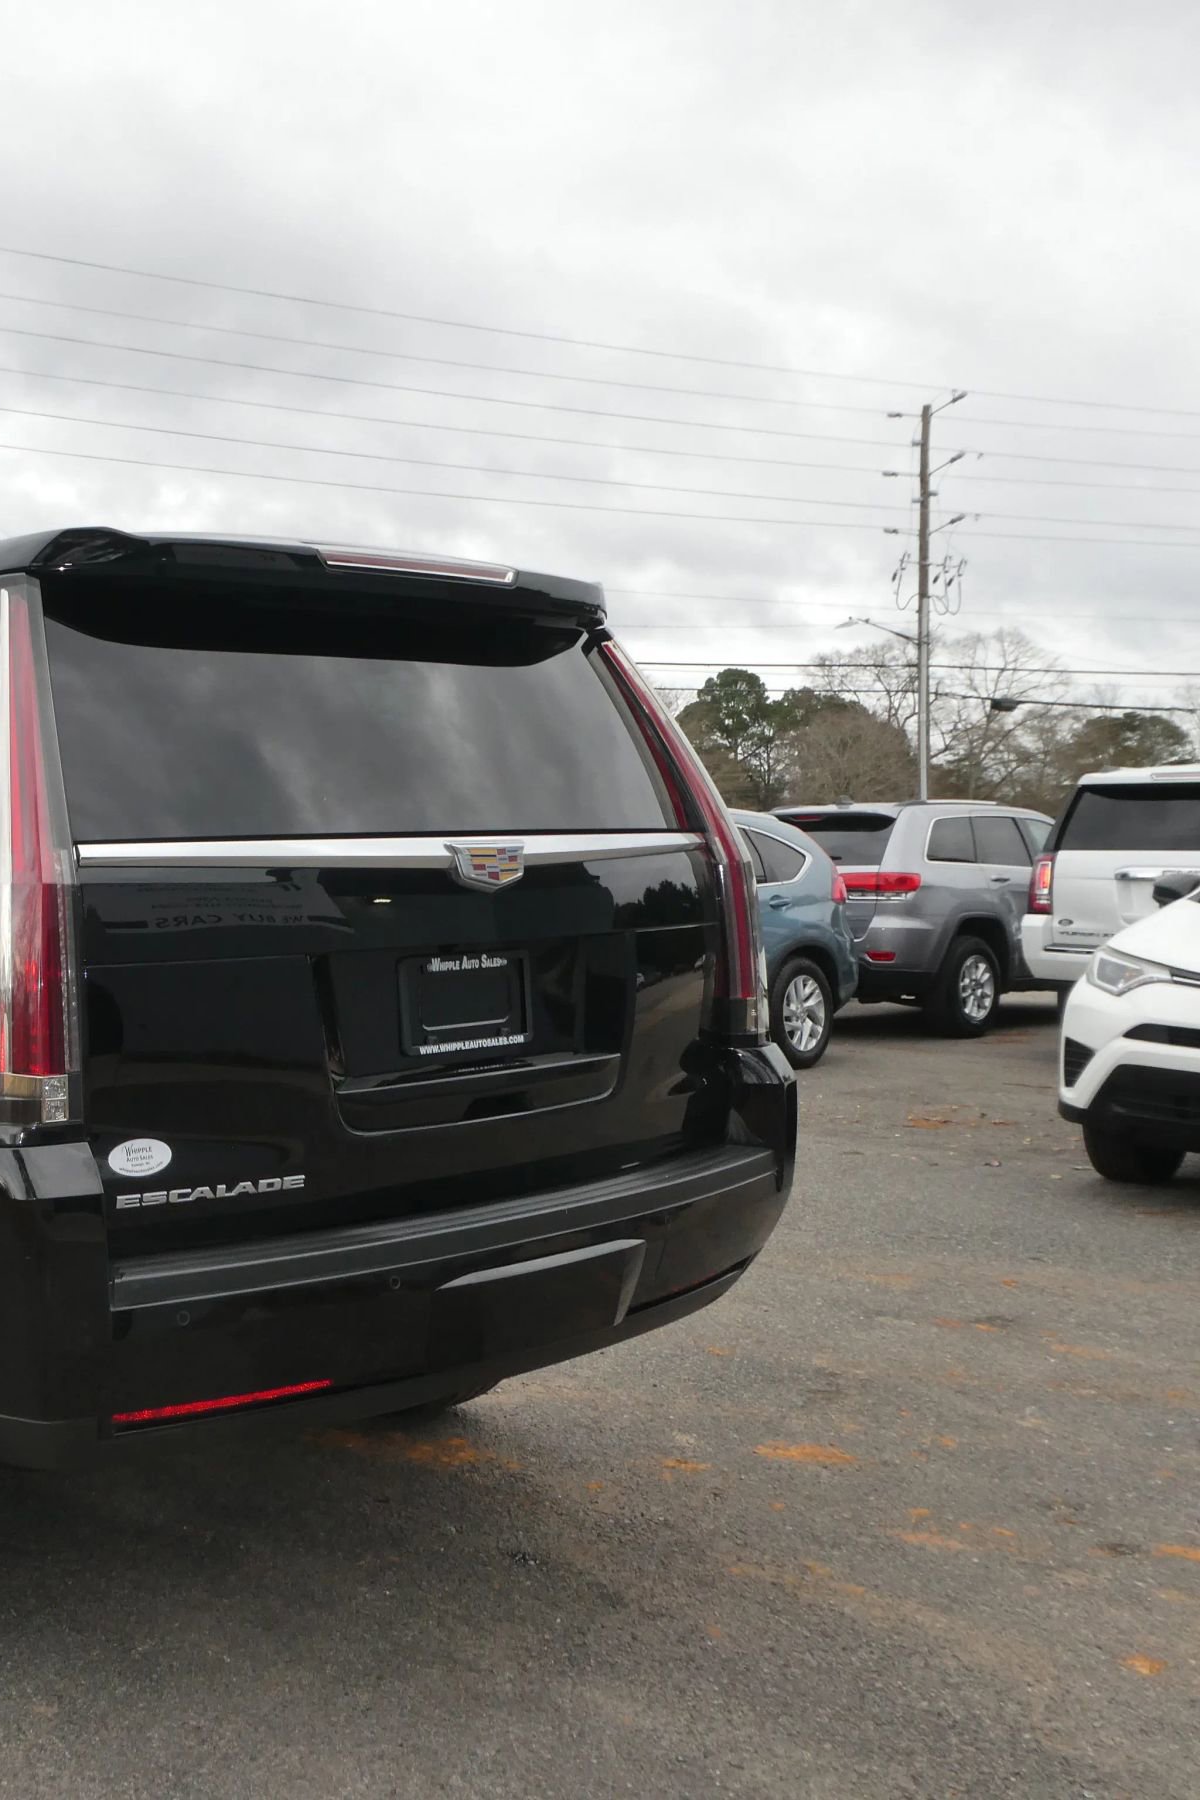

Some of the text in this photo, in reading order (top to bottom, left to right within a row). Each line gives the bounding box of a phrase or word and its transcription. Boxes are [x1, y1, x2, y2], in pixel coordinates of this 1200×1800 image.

[431, 953, 501, 972] WHIPPLE AUTO SALES
[419, 1034, 524, 1055] WWW.WHIPPLEAUTOSALES.COM
[116, 1174, 305, 1209] ESCALADE
